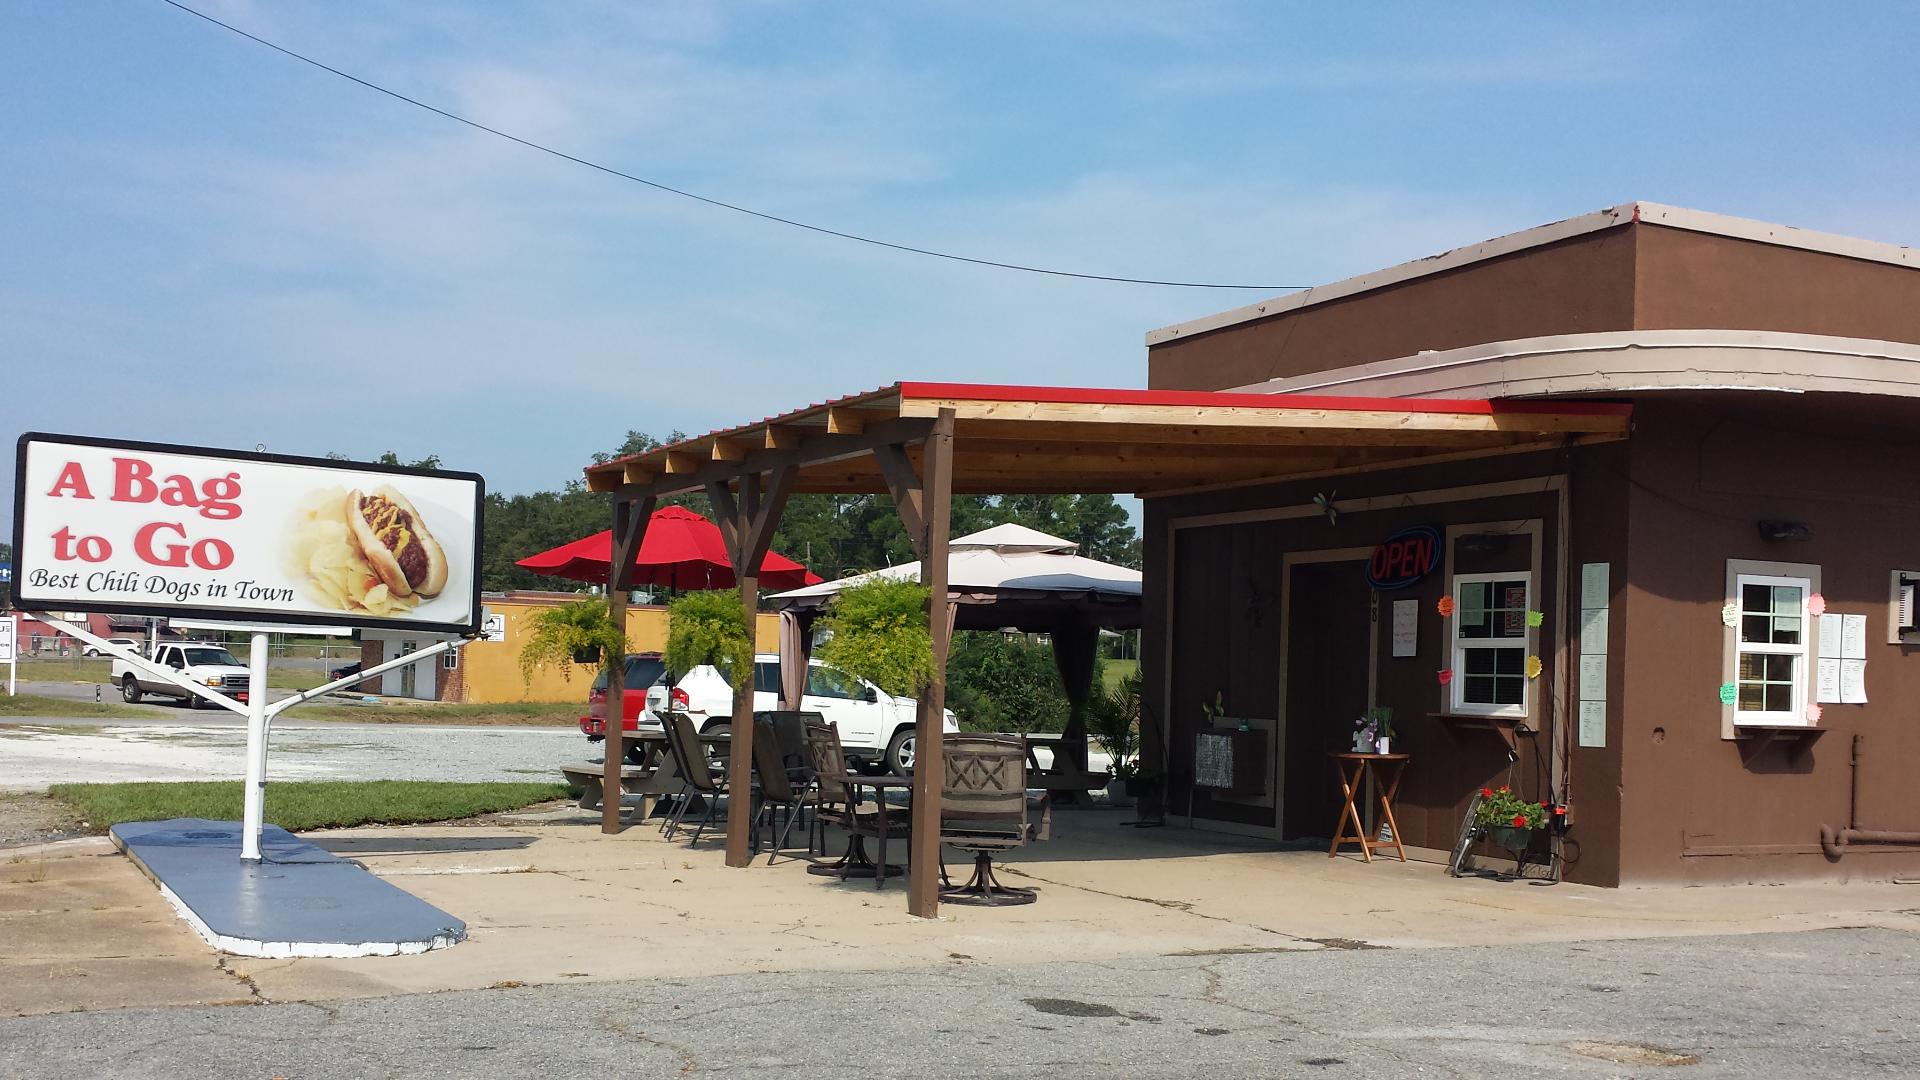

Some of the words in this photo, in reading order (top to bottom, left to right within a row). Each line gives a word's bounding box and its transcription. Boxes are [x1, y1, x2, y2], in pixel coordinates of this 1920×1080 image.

[48, 462, 95, 500] A
[111, 457, 243, 520] Bag
[53, 526, 113, 564] to
[134, 521, 235, 571] Go
[1371, 538, 1433, 580] OPEN
[29, 568, 79, 588] Best
[86, 571, 138, 592] Chili
[144, 575, 201, 602] Dogs
[207, 578, 228, 598] in
[234, 580, 294, 602] Town
